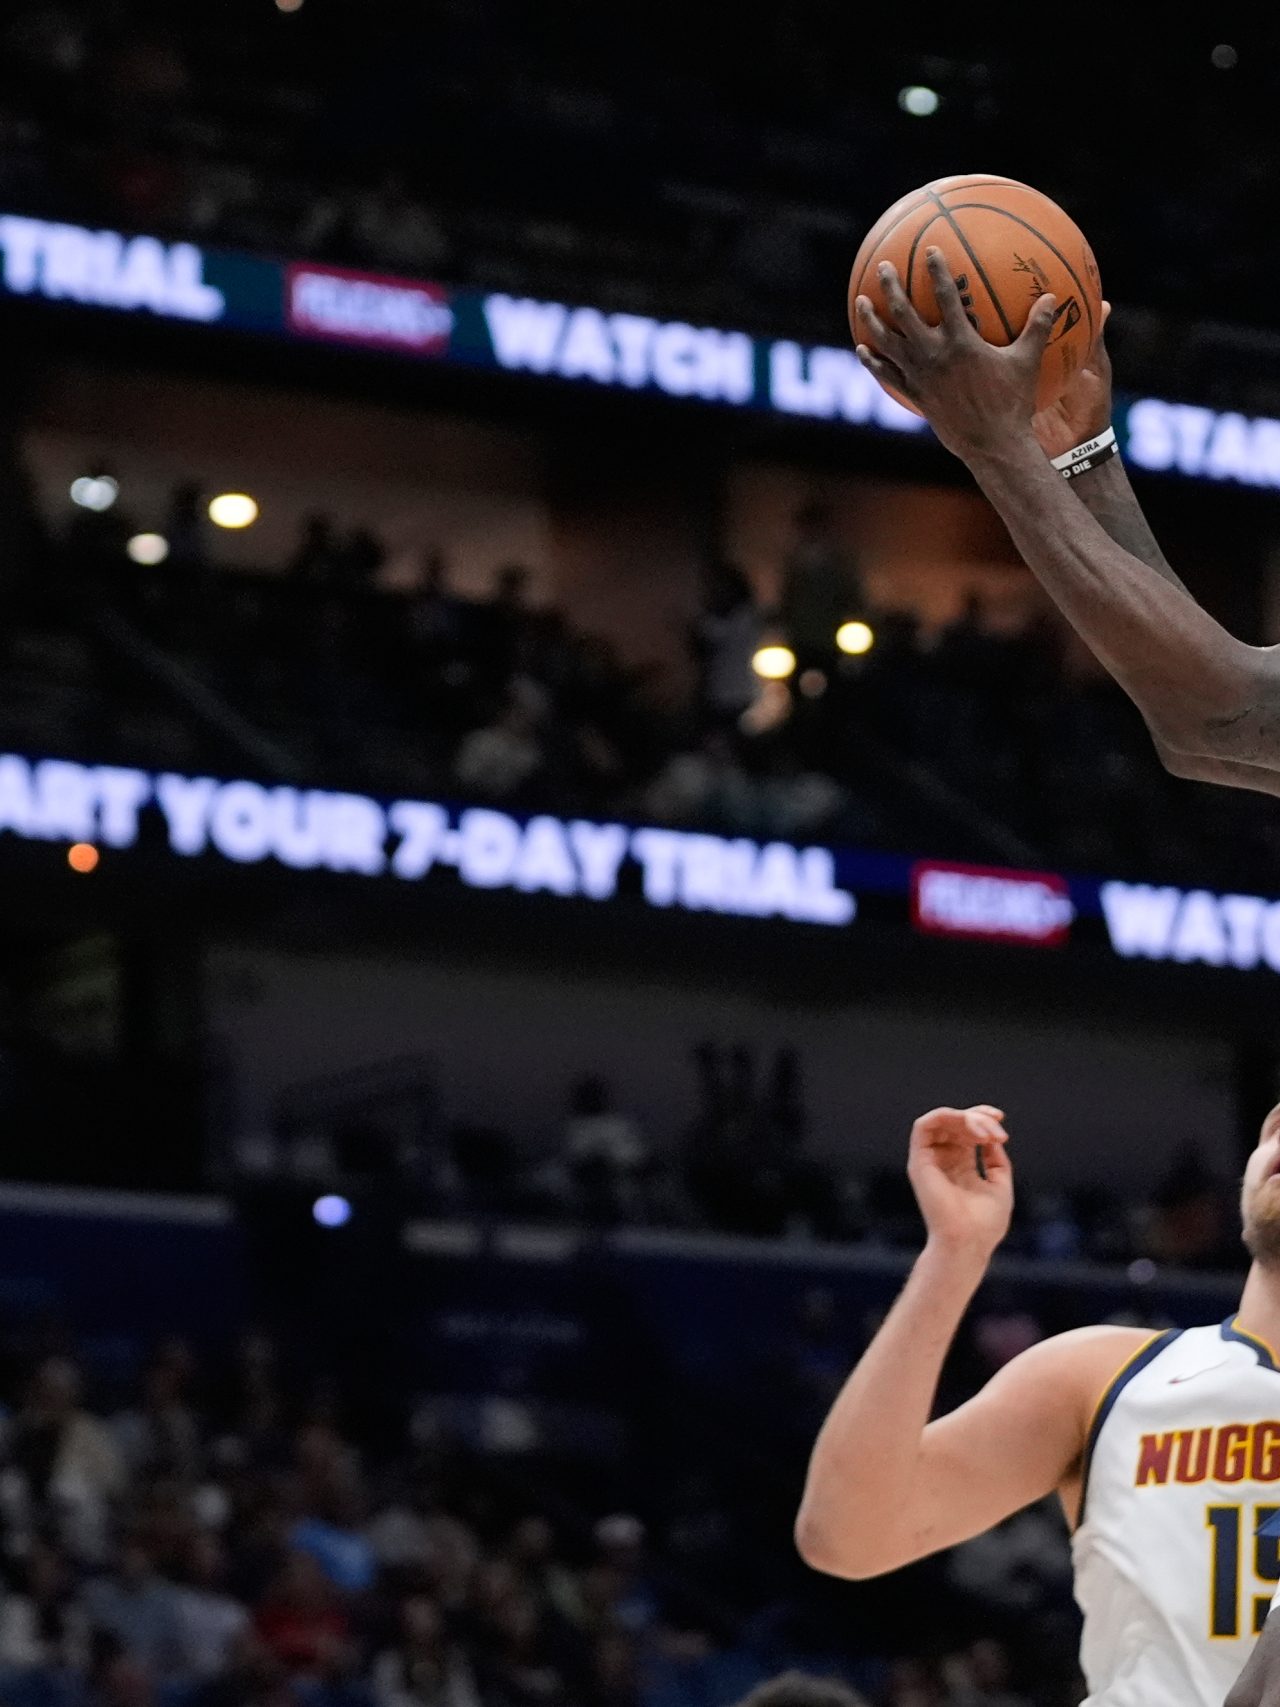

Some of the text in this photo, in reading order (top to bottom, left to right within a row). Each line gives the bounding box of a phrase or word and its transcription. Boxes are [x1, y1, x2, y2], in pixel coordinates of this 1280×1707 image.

[0, 215, 224, 321] TRIAL
[485, 294, 754, 403] WATCH
[1071, 441, 1100, 461] AZIRA
[1072, 460, 1092, 474] DIE
[156, 773, 388, 876] YOUR
[388, 800, 628, 900] 7-DAY
[629, 827, 855, 925] TRIAL
